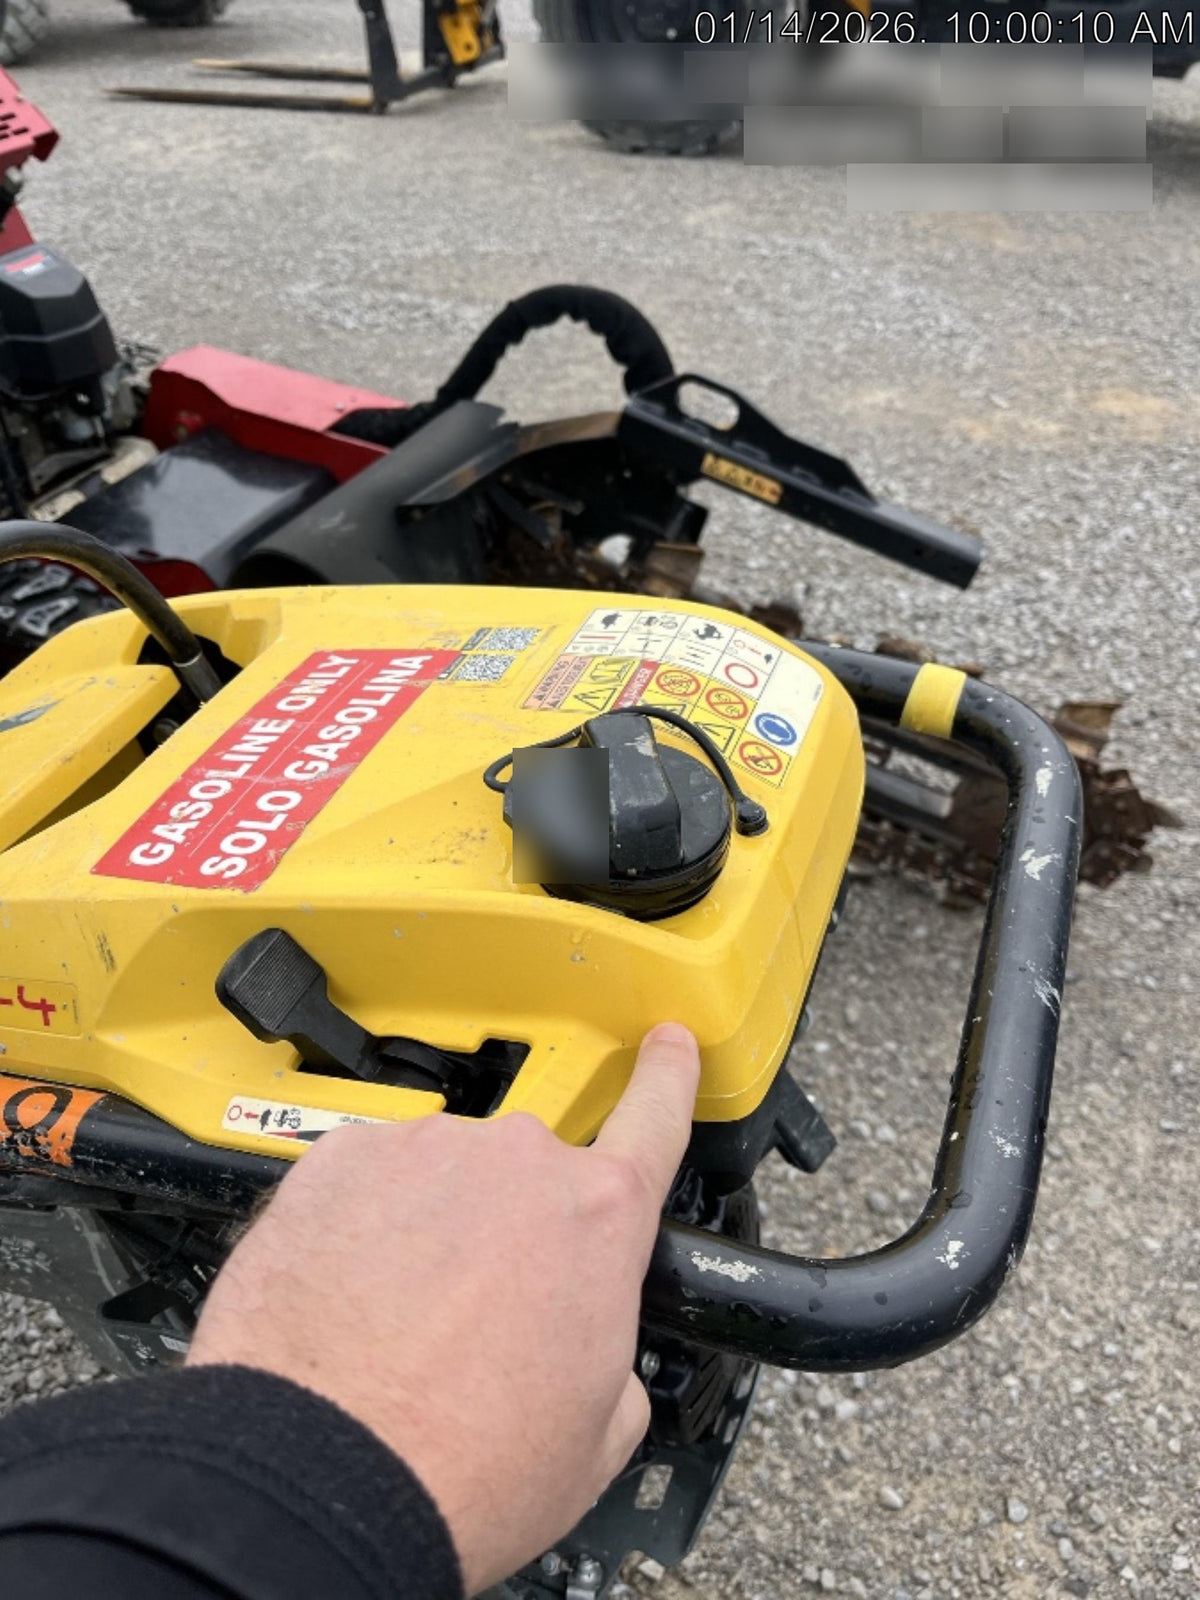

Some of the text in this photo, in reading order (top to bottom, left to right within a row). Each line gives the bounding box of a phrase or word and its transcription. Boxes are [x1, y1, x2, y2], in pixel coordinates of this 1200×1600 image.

[129, 654, 360, 866] GASOLINE ONLY
[200, 655, 433, 878] SOLO GASOLINA
